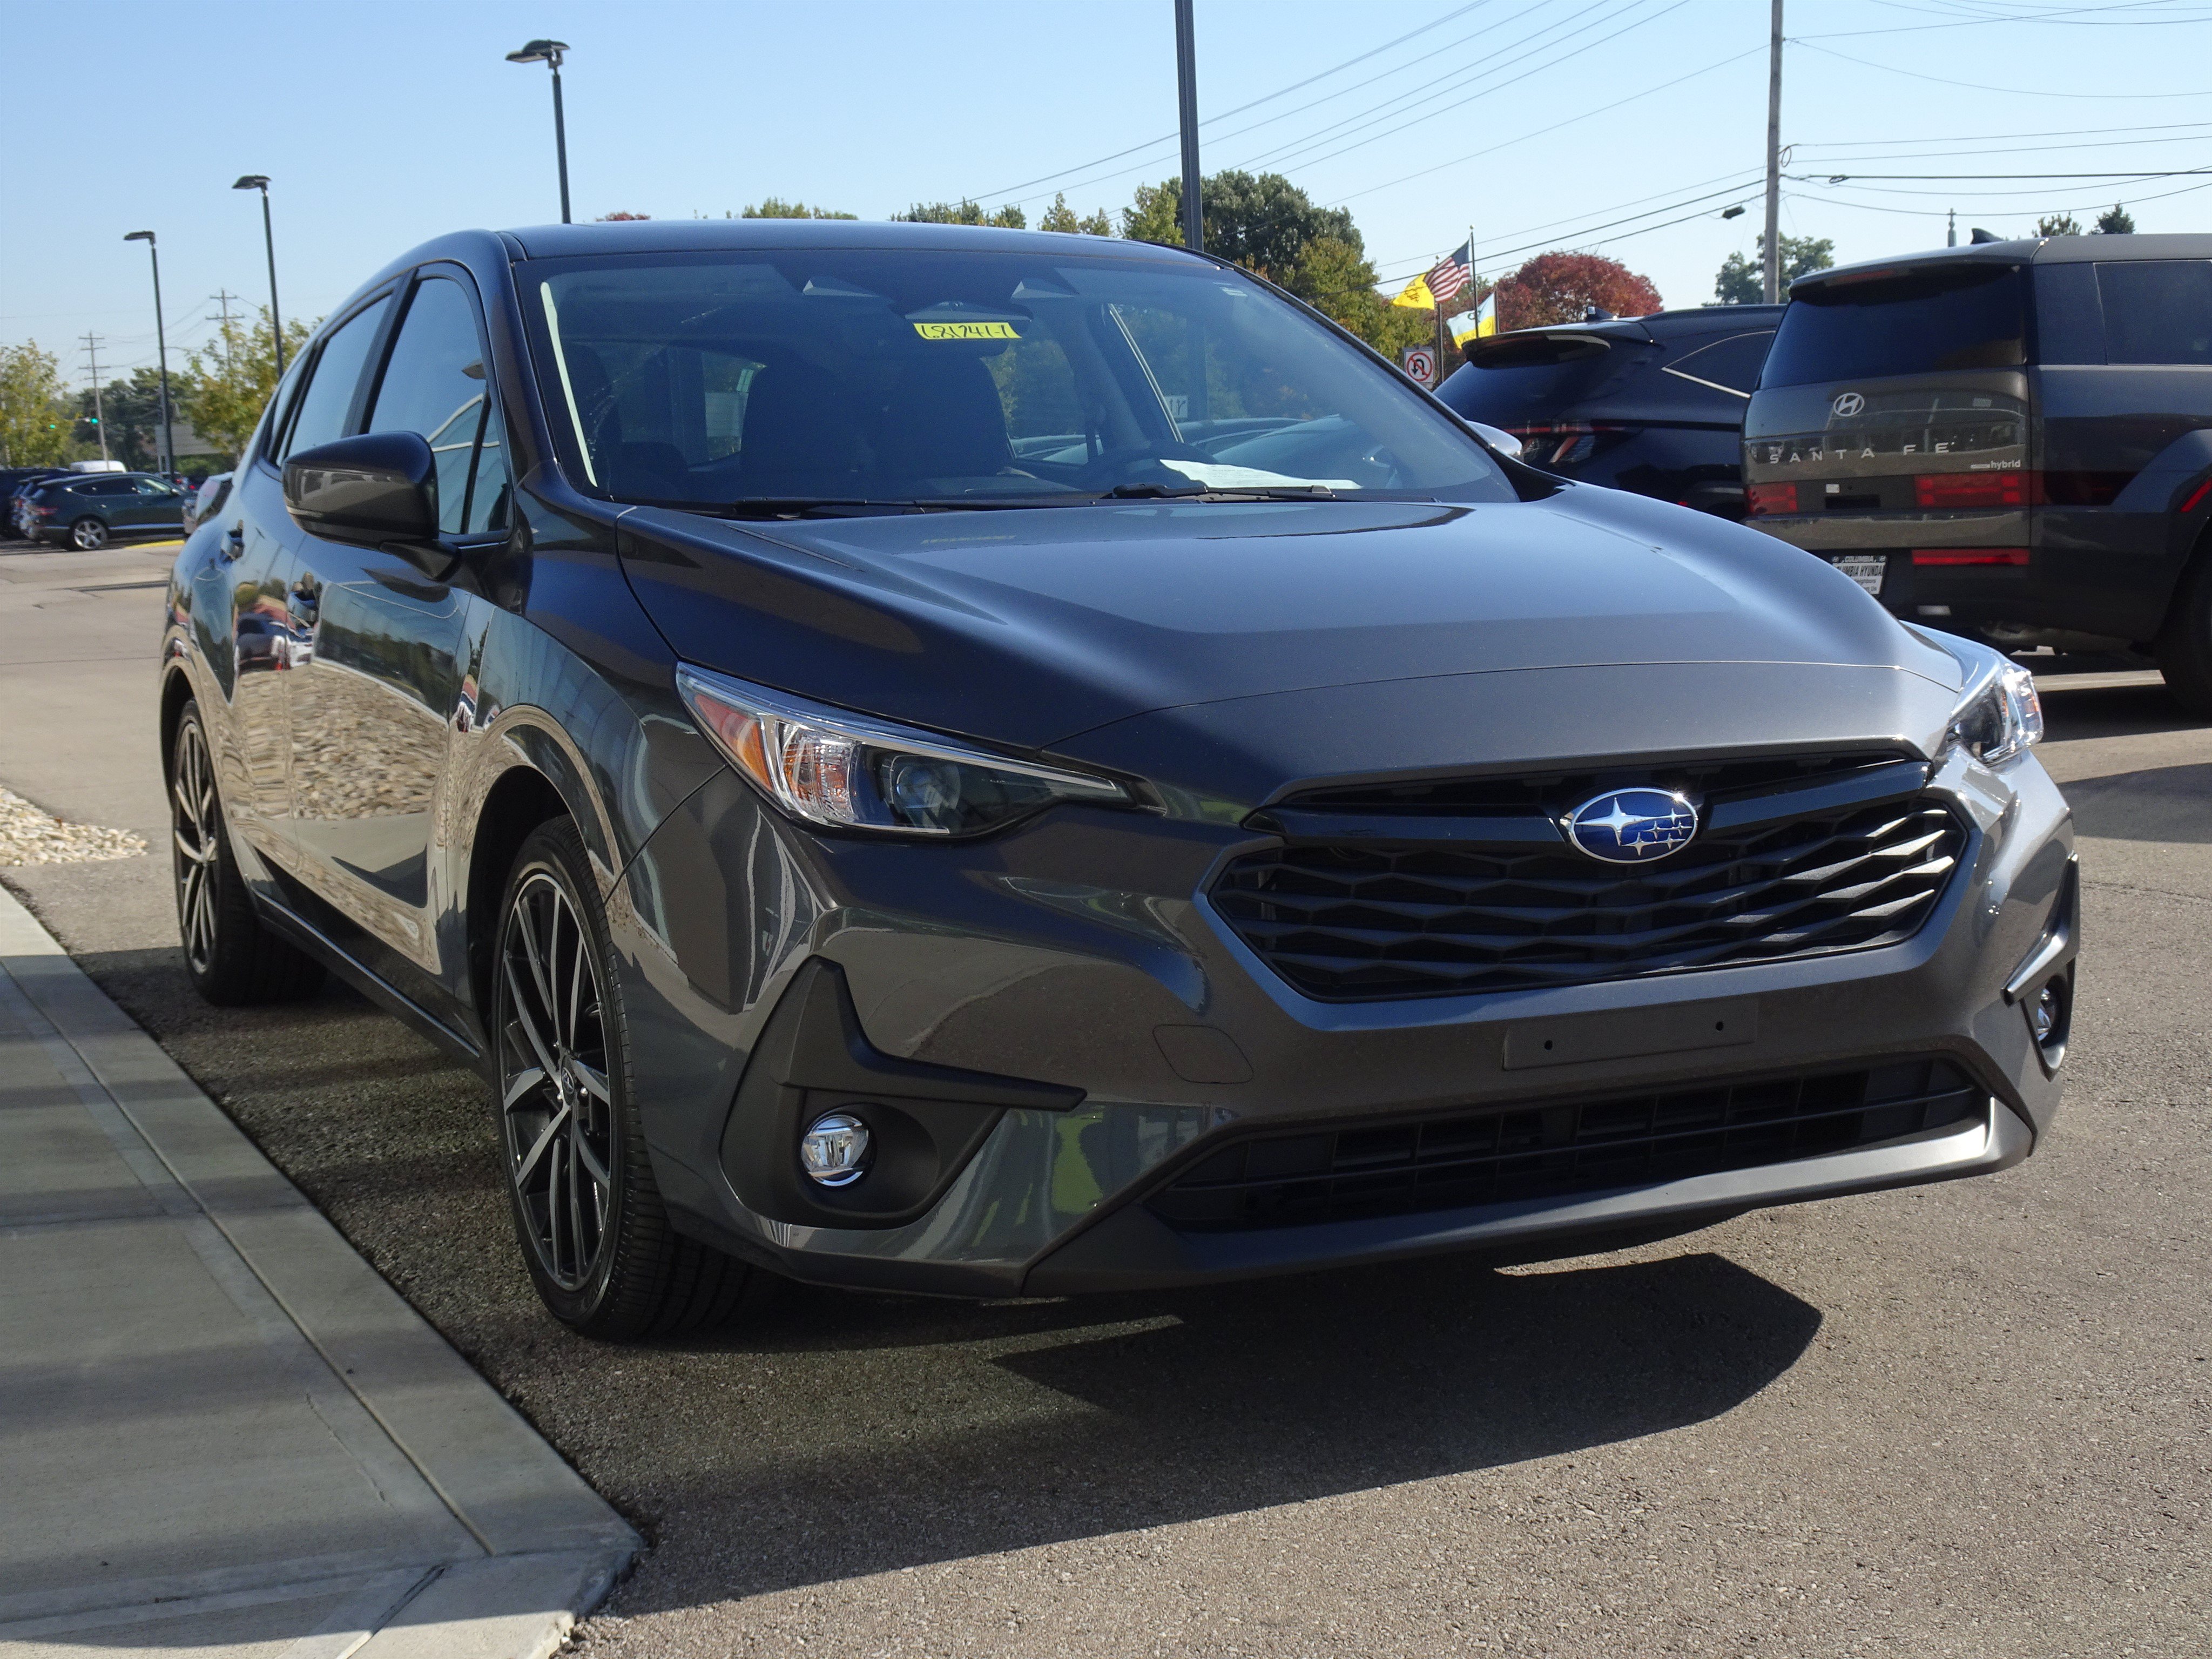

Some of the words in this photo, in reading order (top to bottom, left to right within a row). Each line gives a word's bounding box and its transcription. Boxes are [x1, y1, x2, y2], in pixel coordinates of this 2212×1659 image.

[1769, 448, 1875, 464] SANTA
[1903, 442, 1949, 455] FE
[1990, 460, 2021, 470] hybrid
